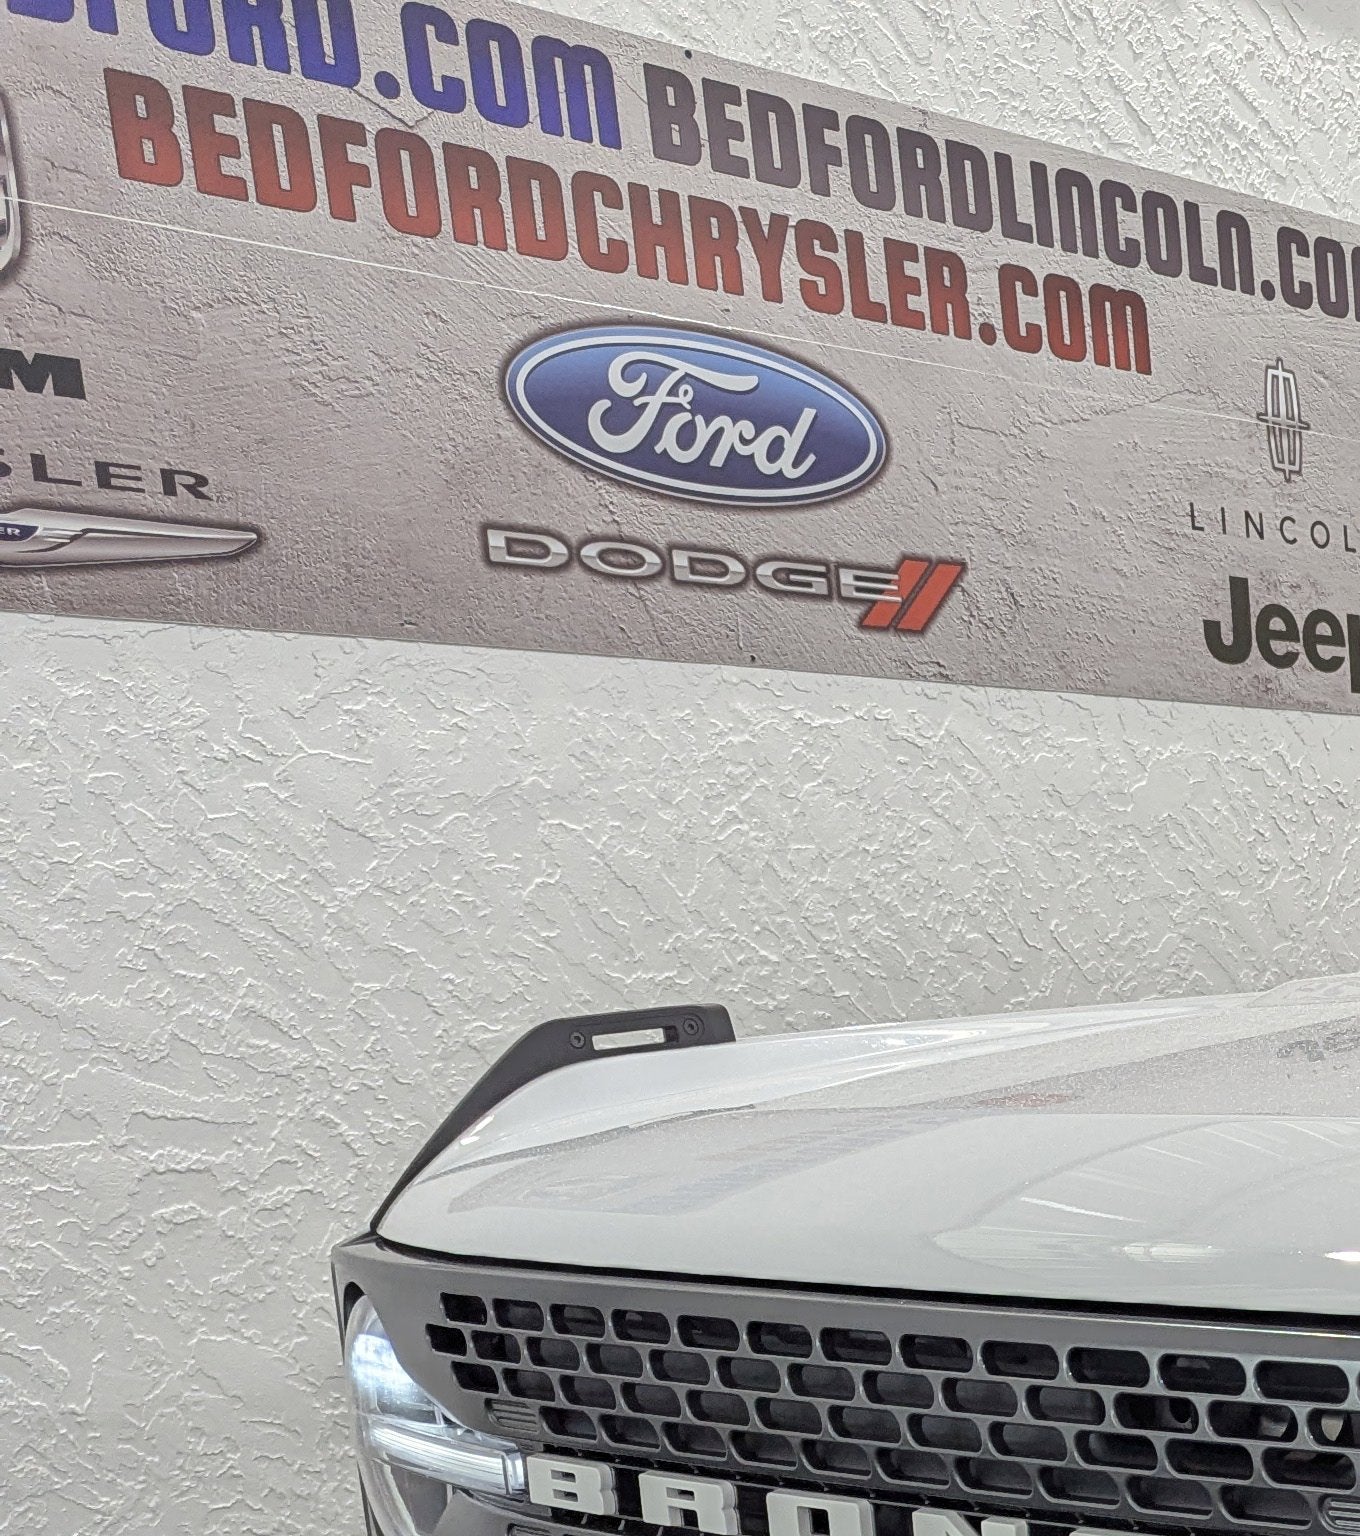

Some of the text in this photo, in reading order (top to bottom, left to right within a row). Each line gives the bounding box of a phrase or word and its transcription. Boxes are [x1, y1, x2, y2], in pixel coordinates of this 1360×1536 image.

[4, 0, 623, 150] ORD.COM
[103, 67, 1152, 376] BEDFORDCHRYSLER.COM
[0, 453, 215, 501] LER
[588, 350, 818, 482] Ford
[485, 527, 903, 604] DODGE
